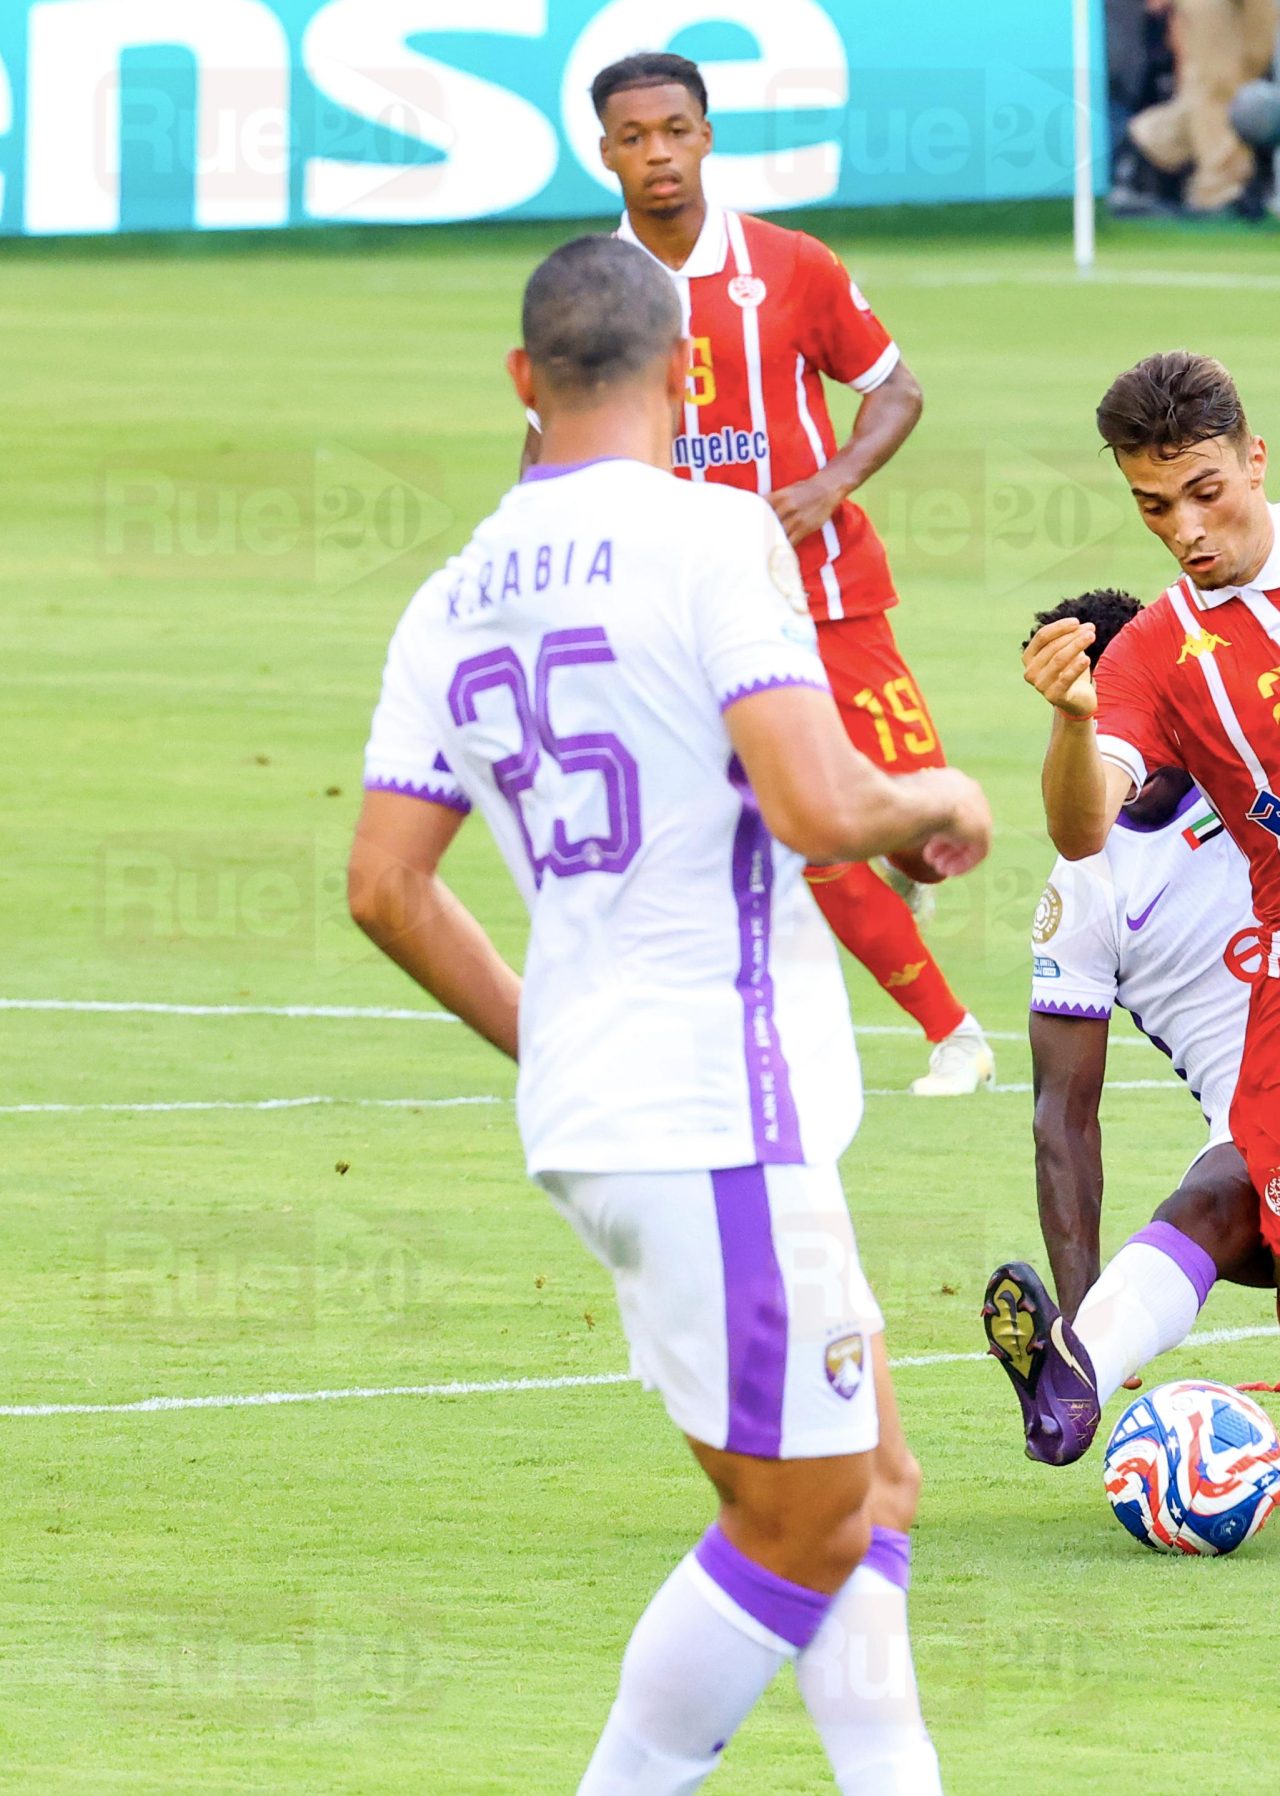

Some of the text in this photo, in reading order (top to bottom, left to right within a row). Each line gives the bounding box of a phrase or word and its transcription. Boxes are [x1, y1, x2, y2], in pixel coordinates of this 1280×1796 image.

[0, 0, 850, 236] nse
[674, 428, 768, 469] ngelec
[448, 626, 642, 890] 25
[853, 675, 936, 763] 19
